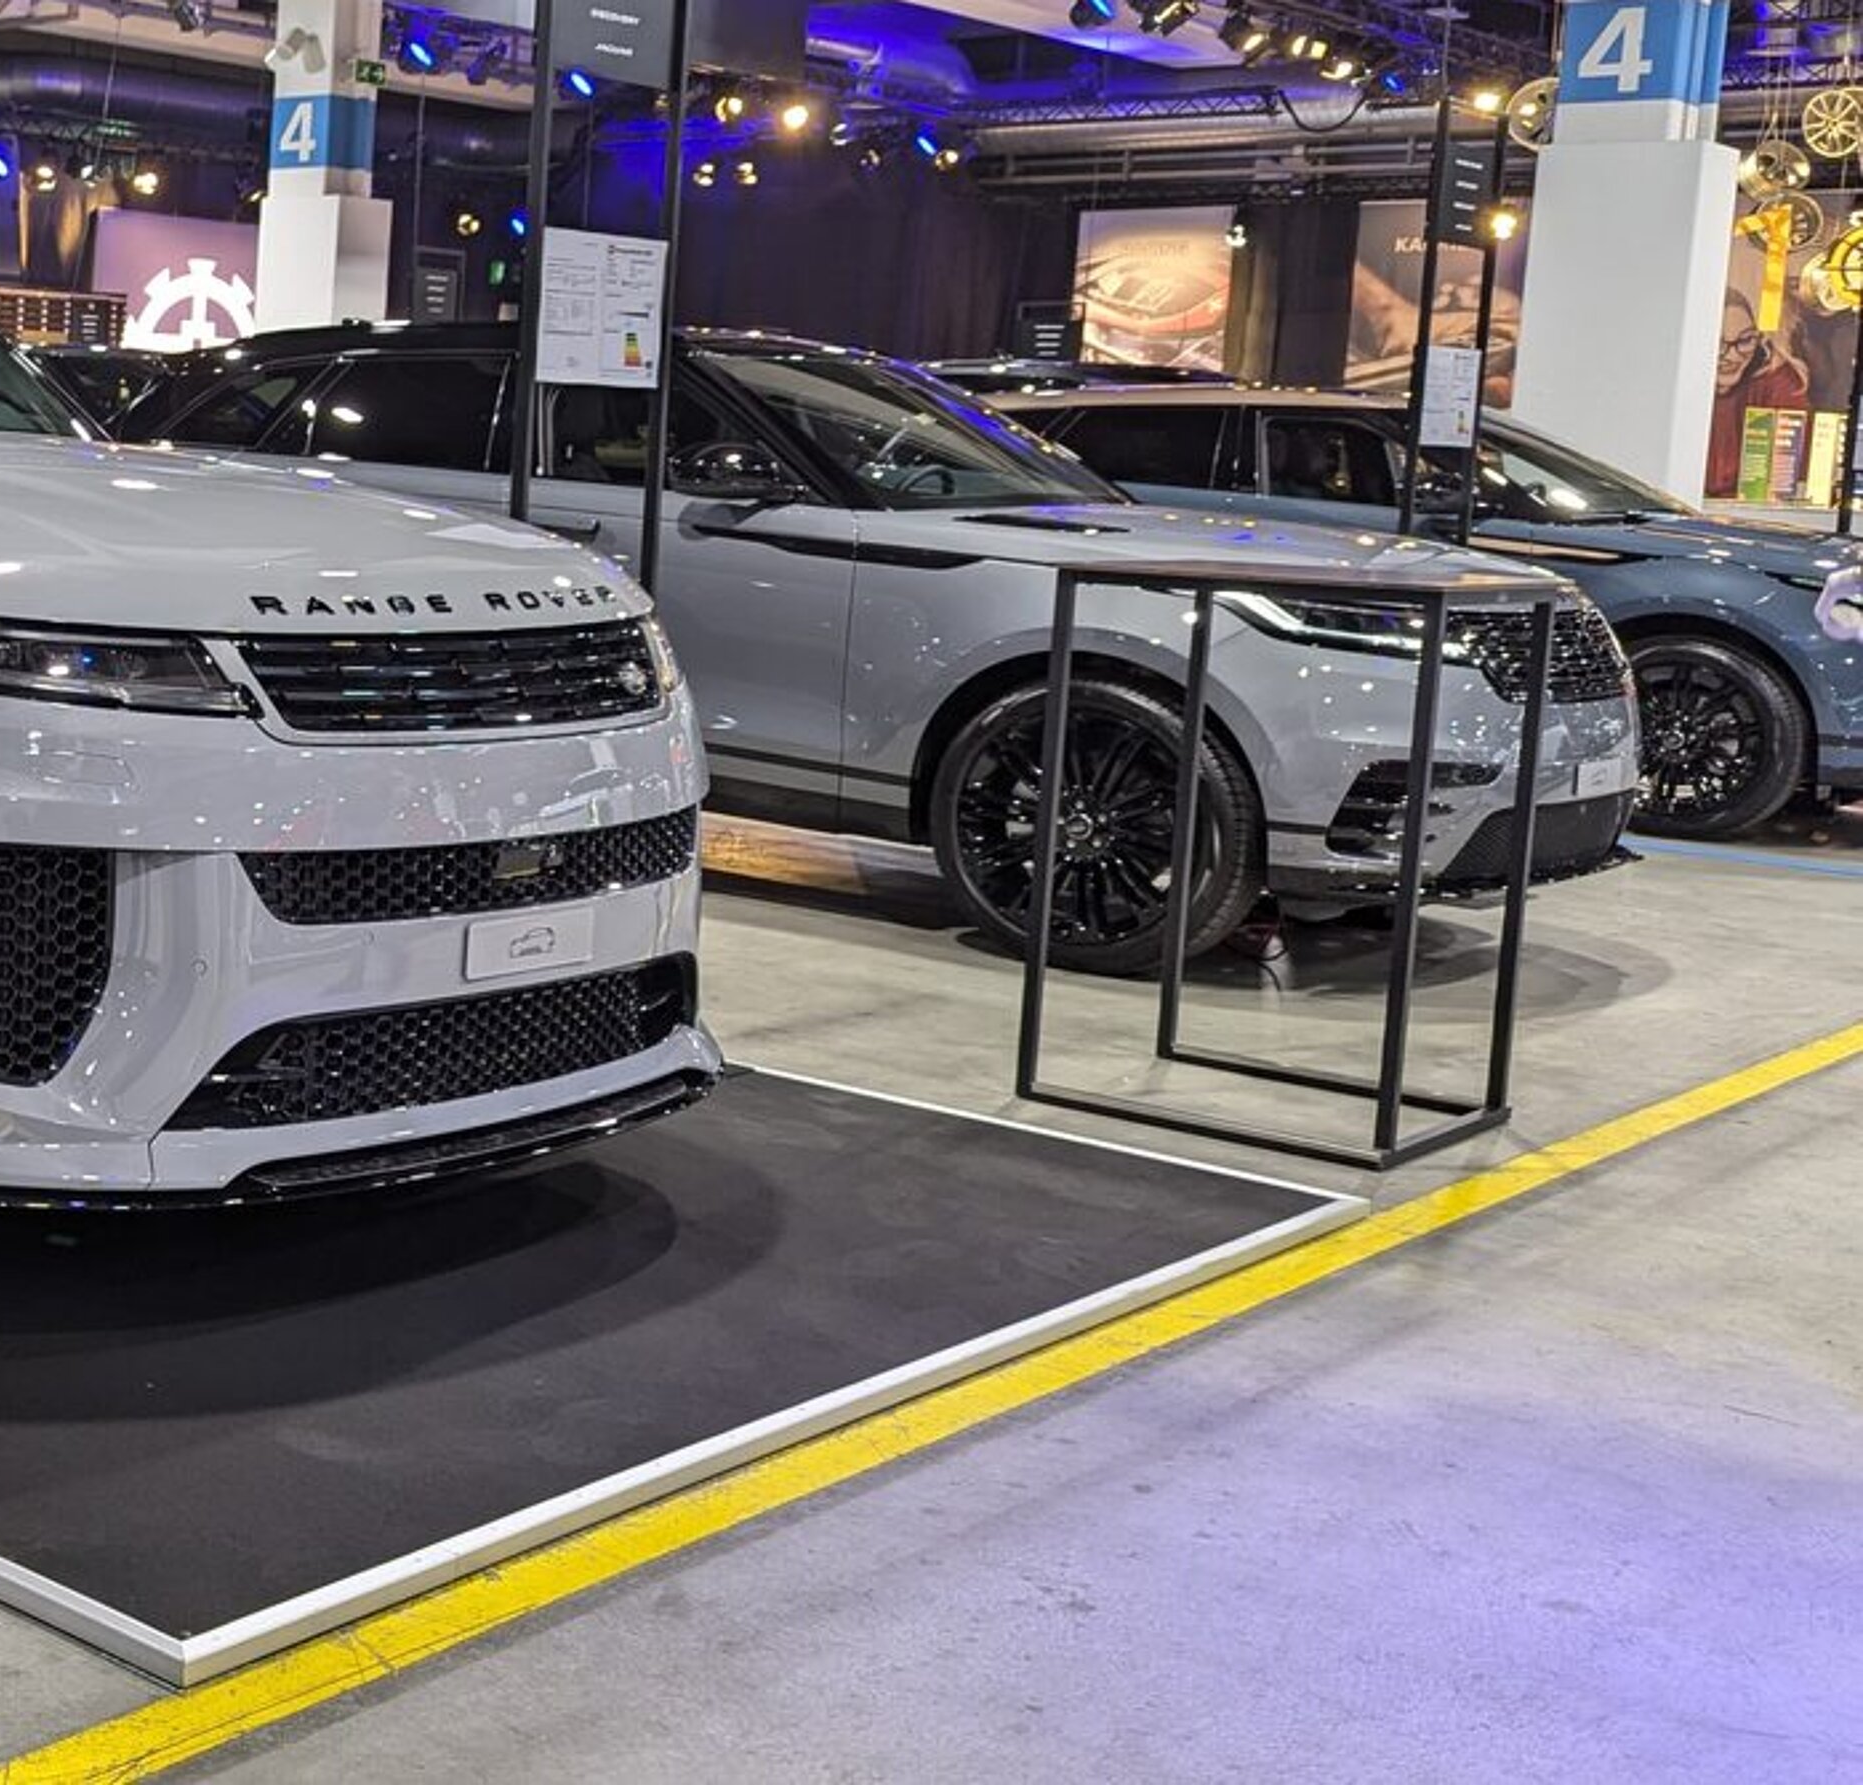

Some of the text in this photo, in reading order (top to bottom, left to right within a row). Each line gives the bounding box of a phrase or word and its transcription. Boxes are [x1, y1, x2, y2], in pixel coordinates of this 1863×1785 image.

[1577, 7, 1653, 92] 4
[280, 101, 317, 162] 4
[249, 585, 618, 616] RANGE ROVER
